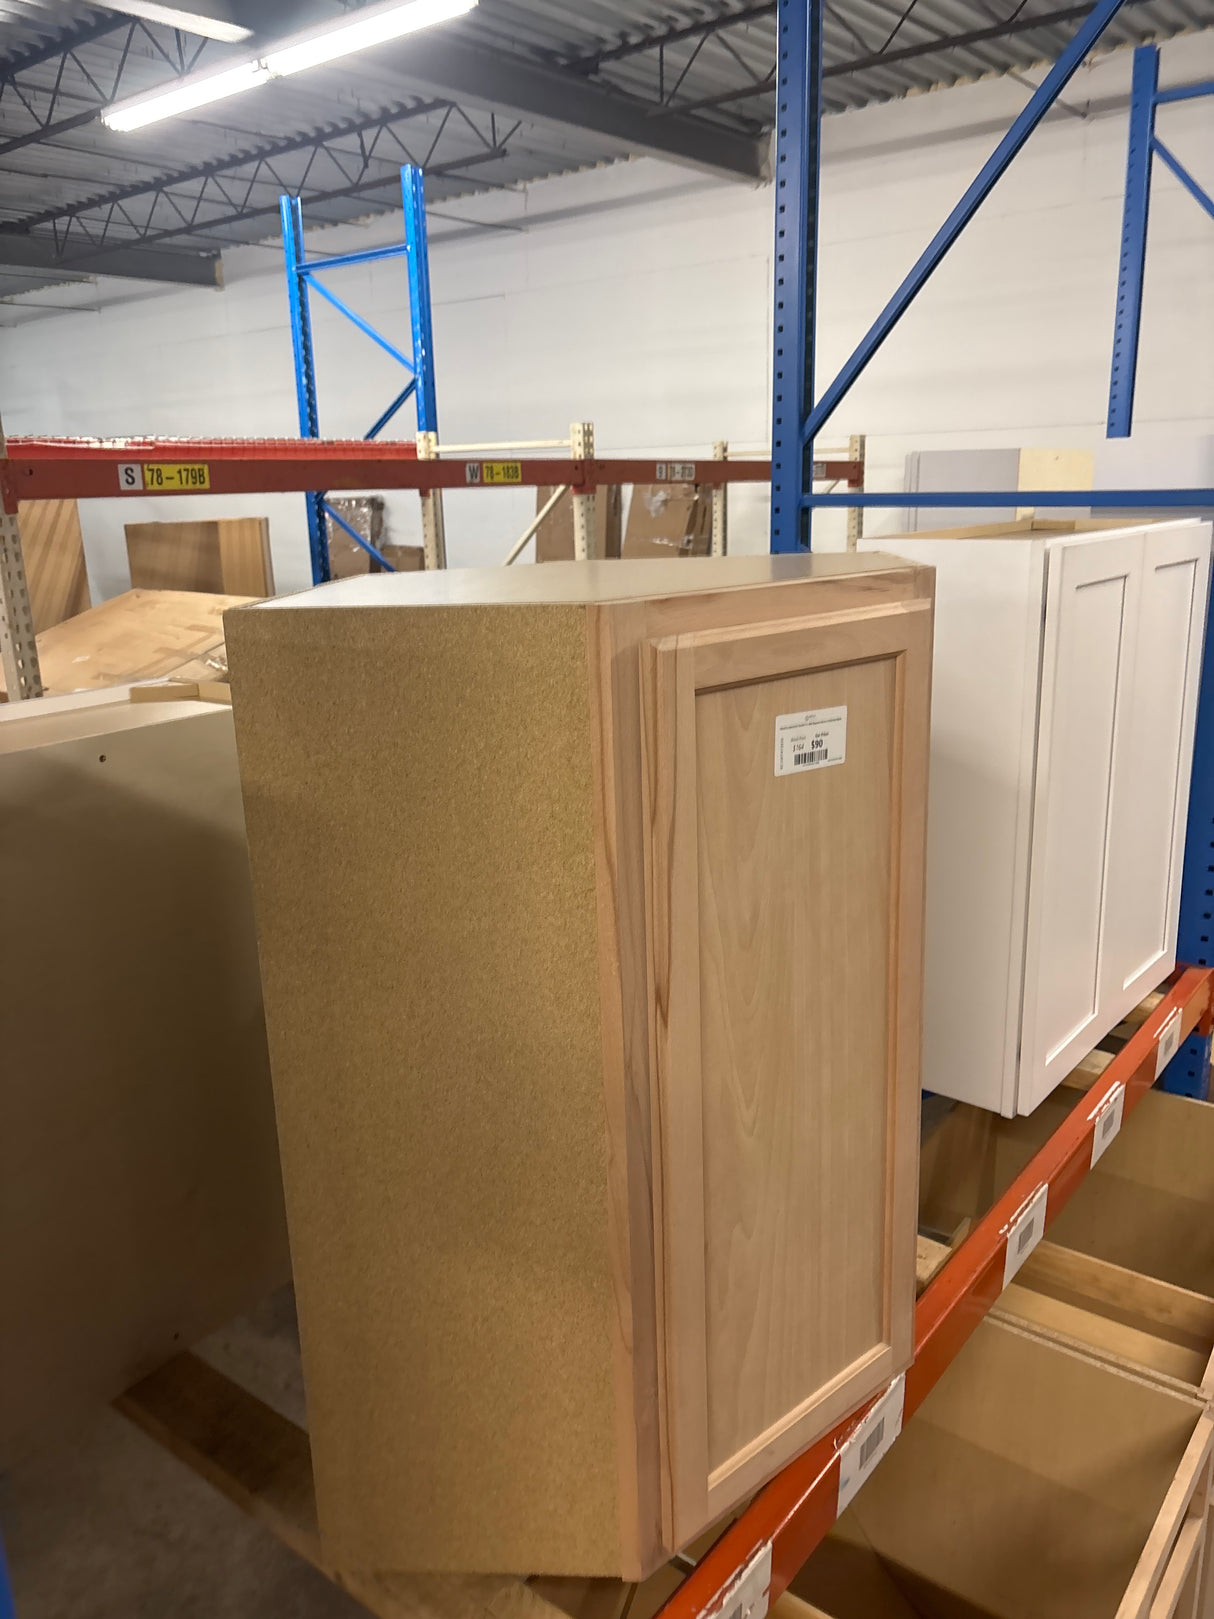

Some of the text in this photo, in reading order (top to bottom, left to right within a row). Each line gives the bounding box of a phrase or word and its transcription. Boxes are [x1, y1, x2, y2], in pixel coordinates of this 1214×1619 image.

[125, 467, 206, 485] S 78-179B
[468, 465, 479, 479] W
[811, 739, 823, 750] $90
